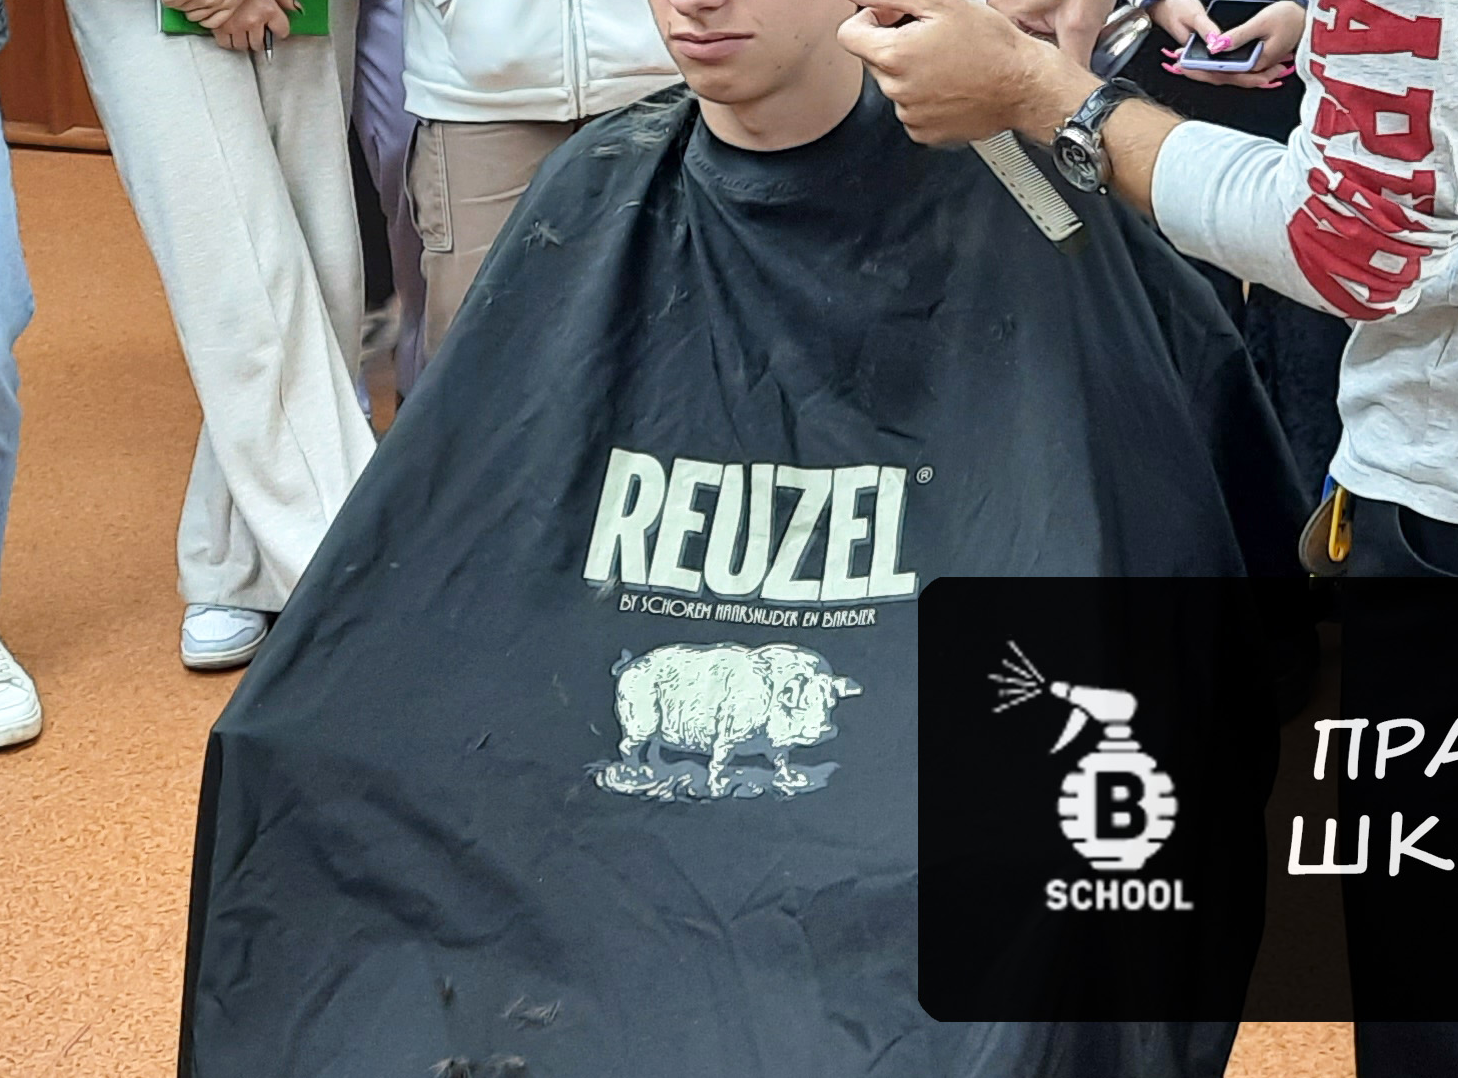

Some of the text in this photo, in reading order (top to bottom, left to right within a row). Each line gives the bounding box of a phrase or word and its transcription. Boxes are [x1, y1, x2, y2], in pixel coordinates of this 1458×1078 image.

[583, 447, 918, 602] REUZEL
[619, 593, 639, 612] BY
[641, 595, 713, 619] SCHOREM
[802, 611, 820, 627] EN
[821, 608, 876, 628] BARBIER
